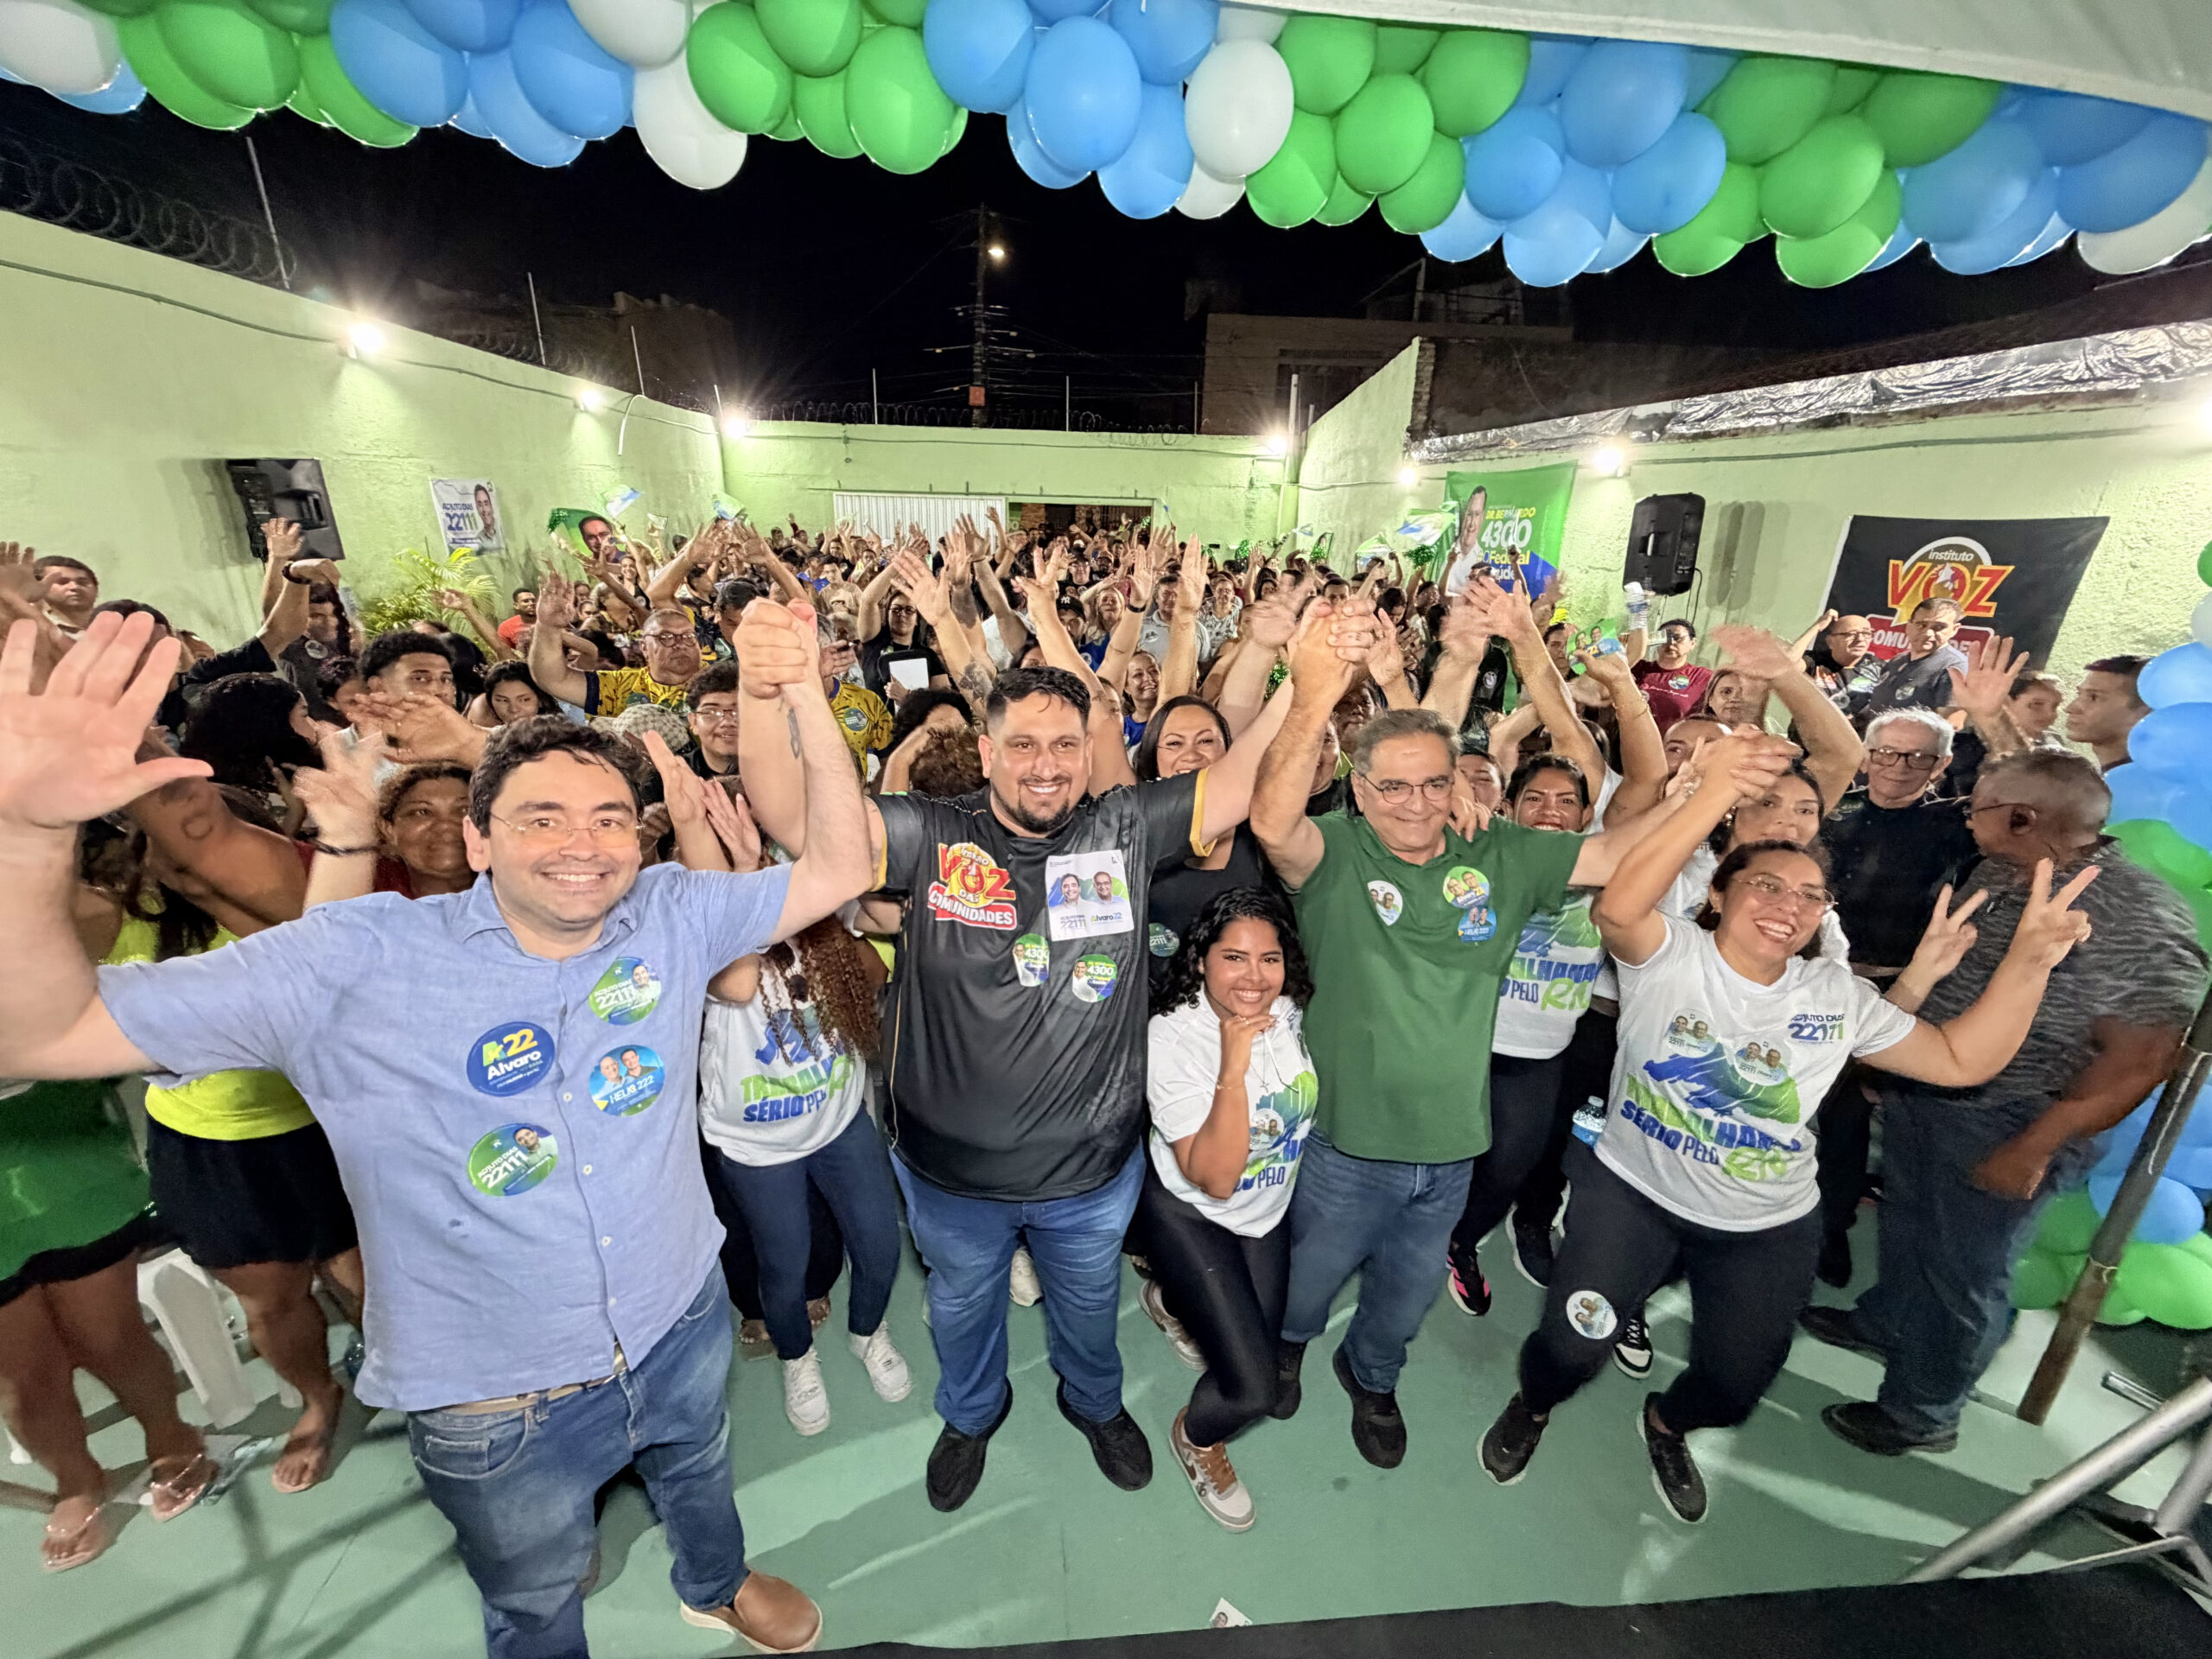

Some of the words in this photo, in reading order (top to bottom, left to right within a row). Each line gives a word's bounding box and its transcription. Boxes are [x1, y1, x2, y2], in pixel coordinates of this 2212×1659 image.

[1480, 518, 1533, 549] 4300
[1928, 548, 1974, 563] instituto
[1888, 559, 2015, 618] VOZ
[938, 842, 1017, 901] VOZ
[958, 888, 980, 903] DAS
[1087, 964, 1115, 976] 4300
[1510, 979, 1540, 1004] PELO
[1788, 1022, 1844, 1041] 22111
[636, 1074, 655, 1090] 222
[743, 1095, 805, 1122] SÉRIO
[477, 1156, 504, 1179] ADJUTO
[501, 1146, 519, 1160] DIAS
[481, 1149, 529, 1189] 22111
[1257, 1166, 1286, 1190] PELO
